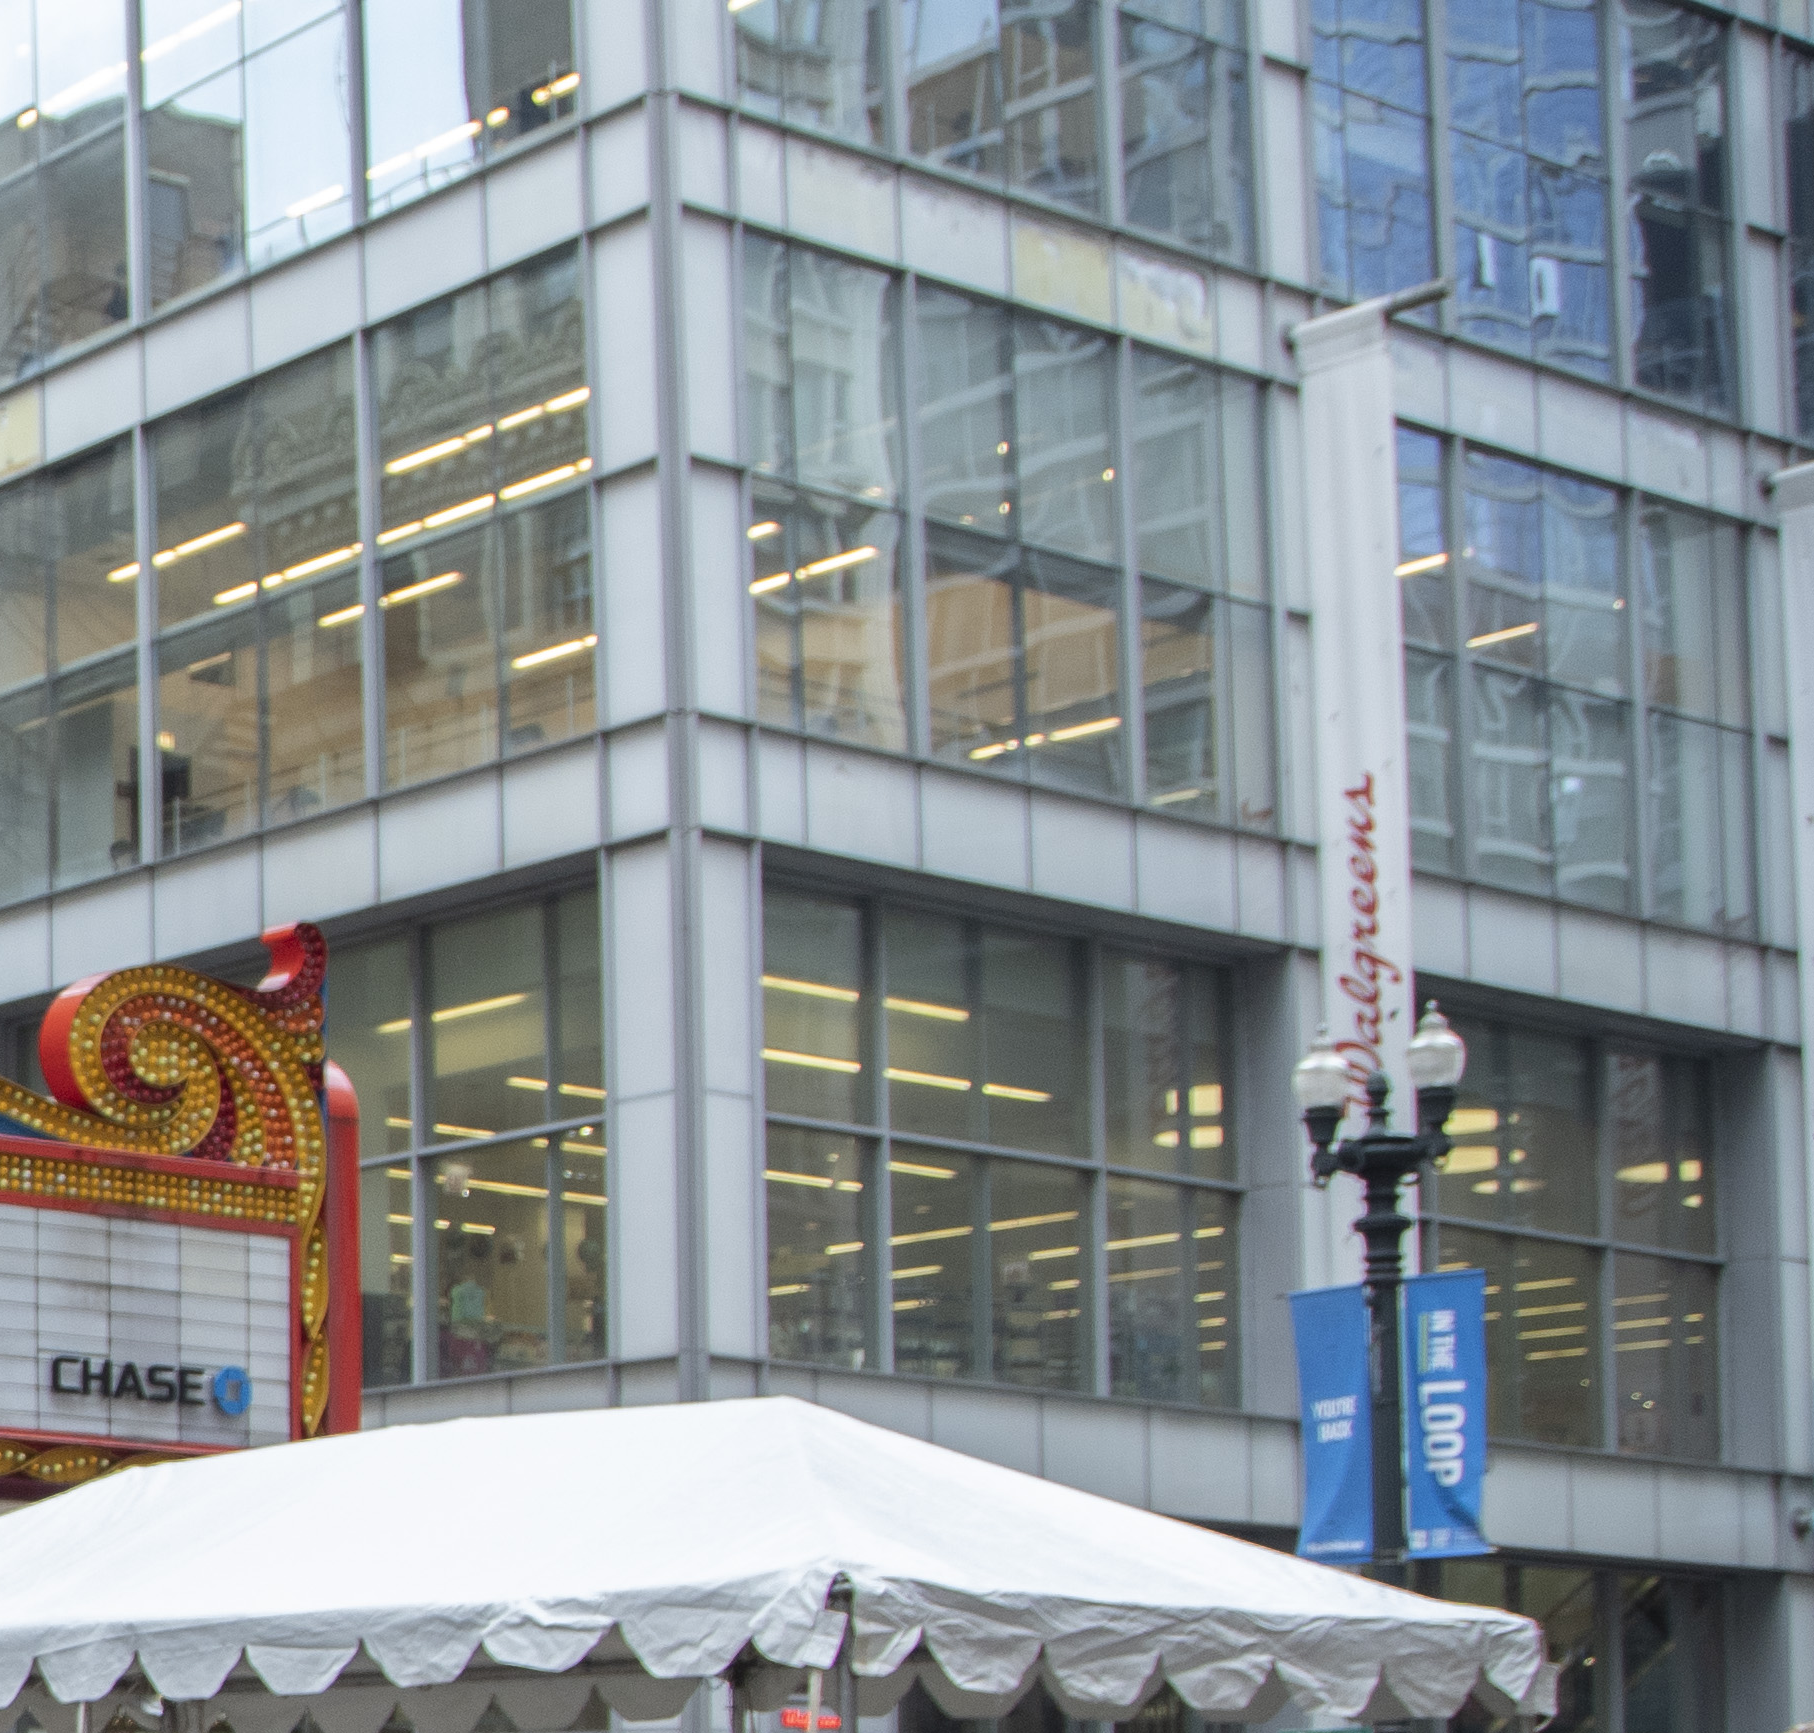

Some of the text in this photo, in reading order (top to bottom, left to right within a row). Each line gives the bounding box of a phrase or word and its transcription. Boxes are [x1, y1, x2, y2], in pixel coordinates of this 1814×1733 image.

[1335, 770, 1401, 1121] Walgreens
[51, 1355, 206, 1405] CHASE
[1427, 1309, 1457, 1371] IN THE
[1418, 1379, 1467, 1487] LOOP
